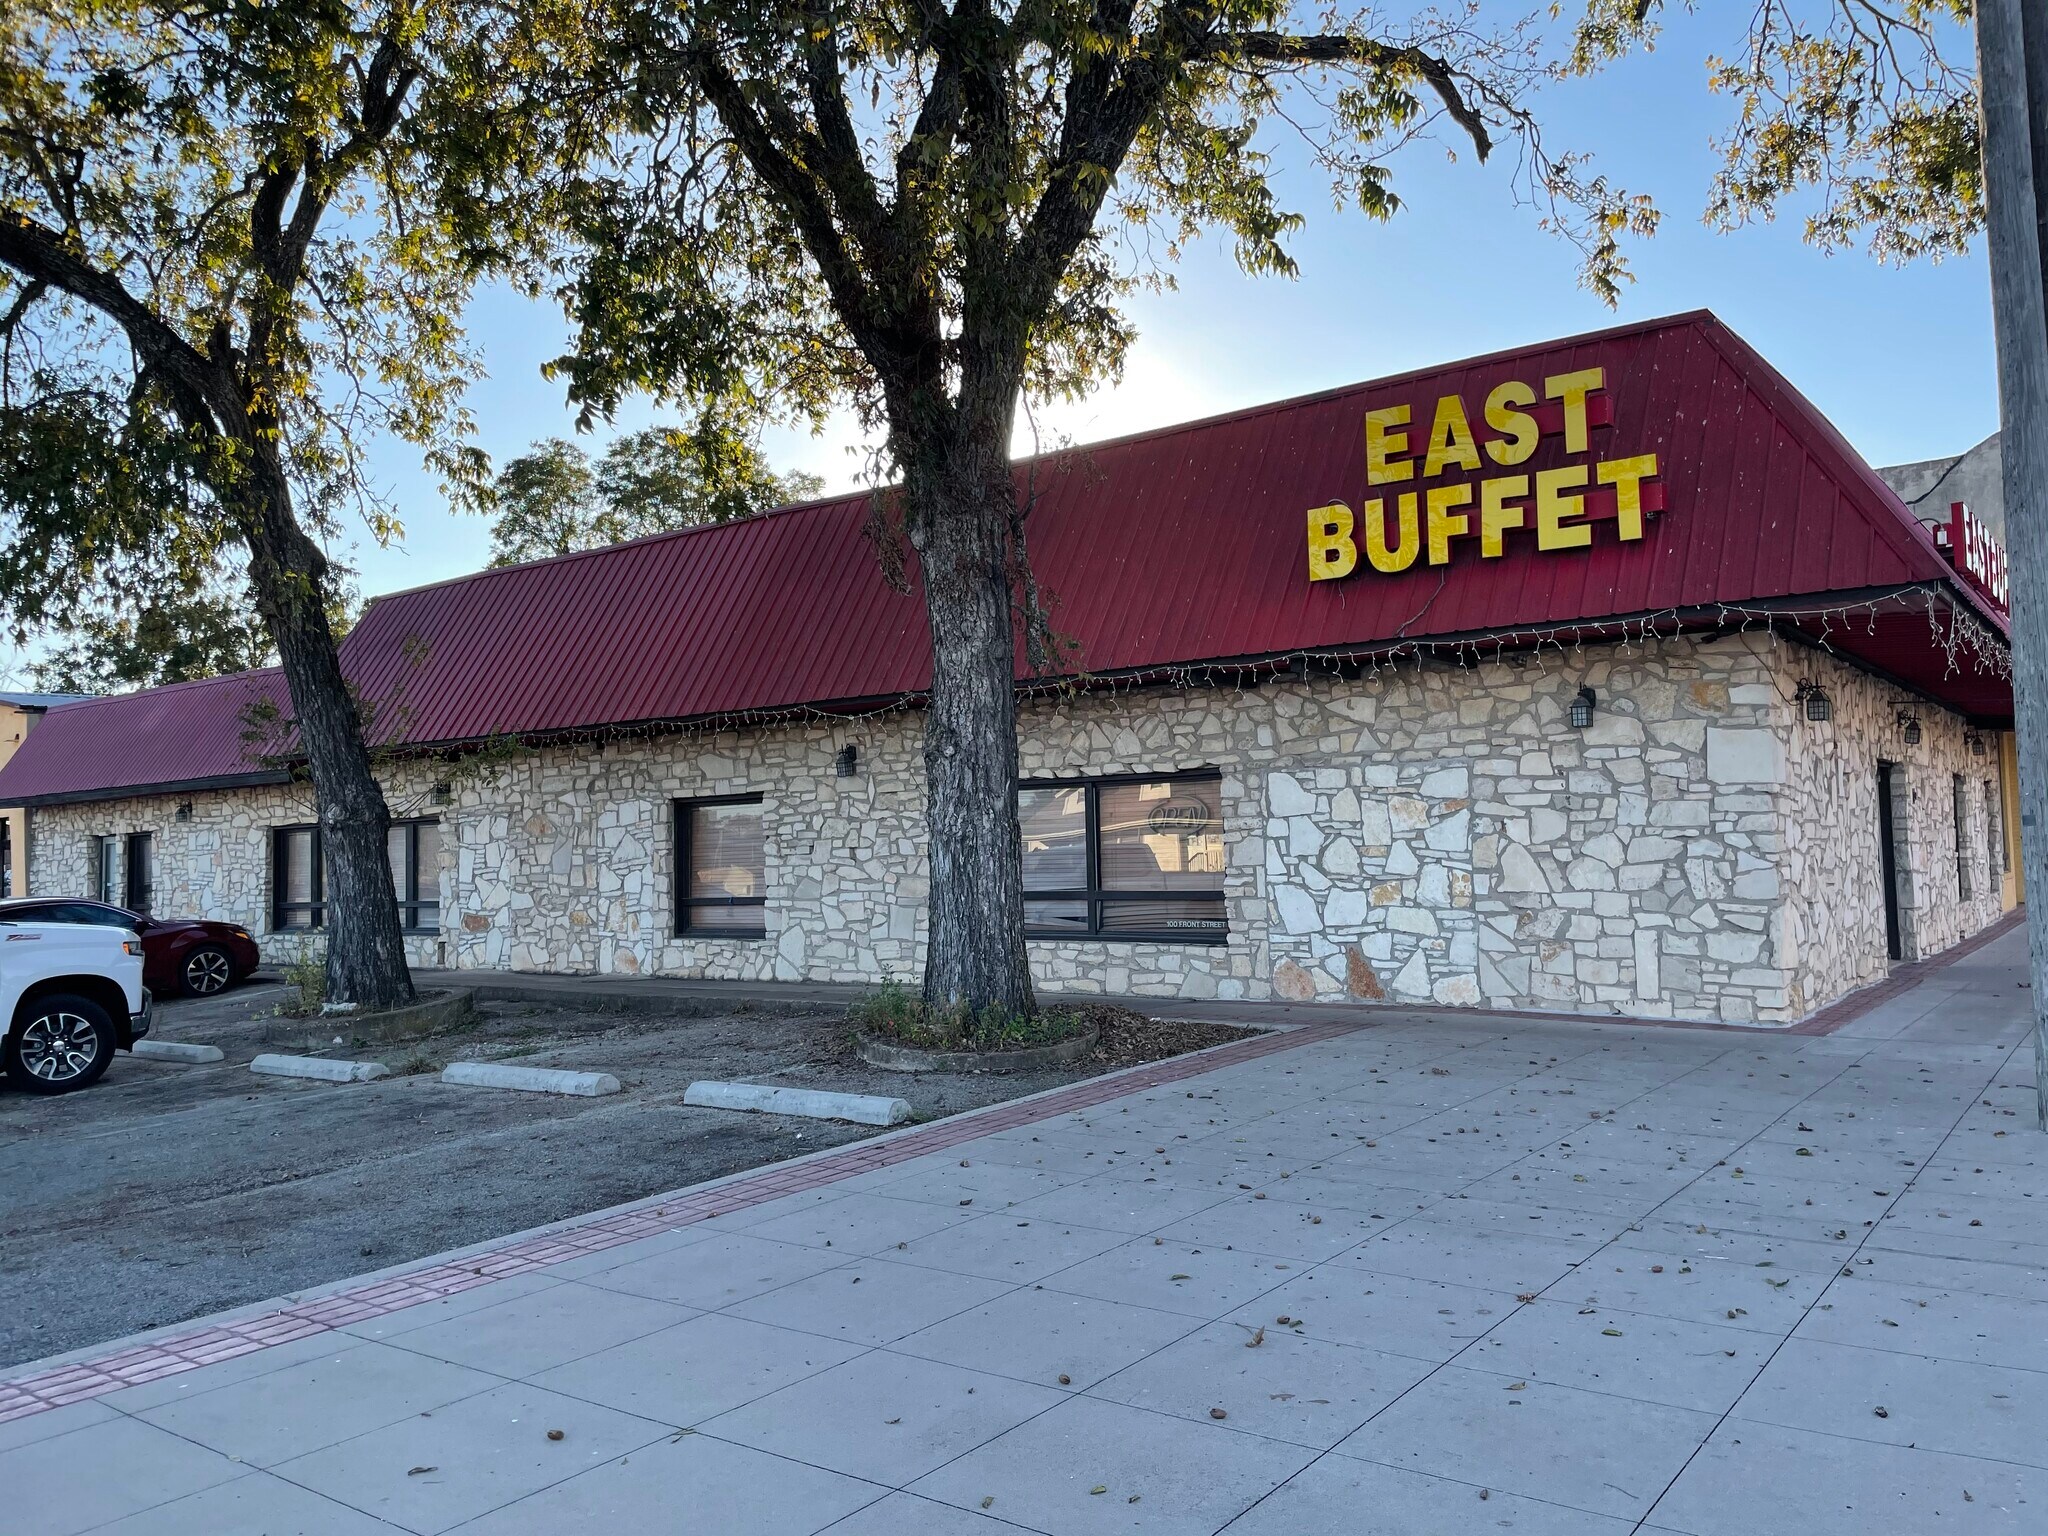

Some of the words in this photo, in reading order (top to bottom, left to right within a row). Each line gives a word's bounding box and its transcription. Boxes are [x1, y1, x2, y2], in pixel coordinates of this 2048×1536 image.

[1365, 366, 1607, 486] EAST
[1306, 453, 1659, 582] BUFFET
[1963, 503, 1991, 589] EAST
[1150, 805, 1203, 829] OPEN
[1166, 920, 1178, 929] 100
[1178, 920, 1201, 929] FRONT
[1201, 920, 1226, 929] STREET
